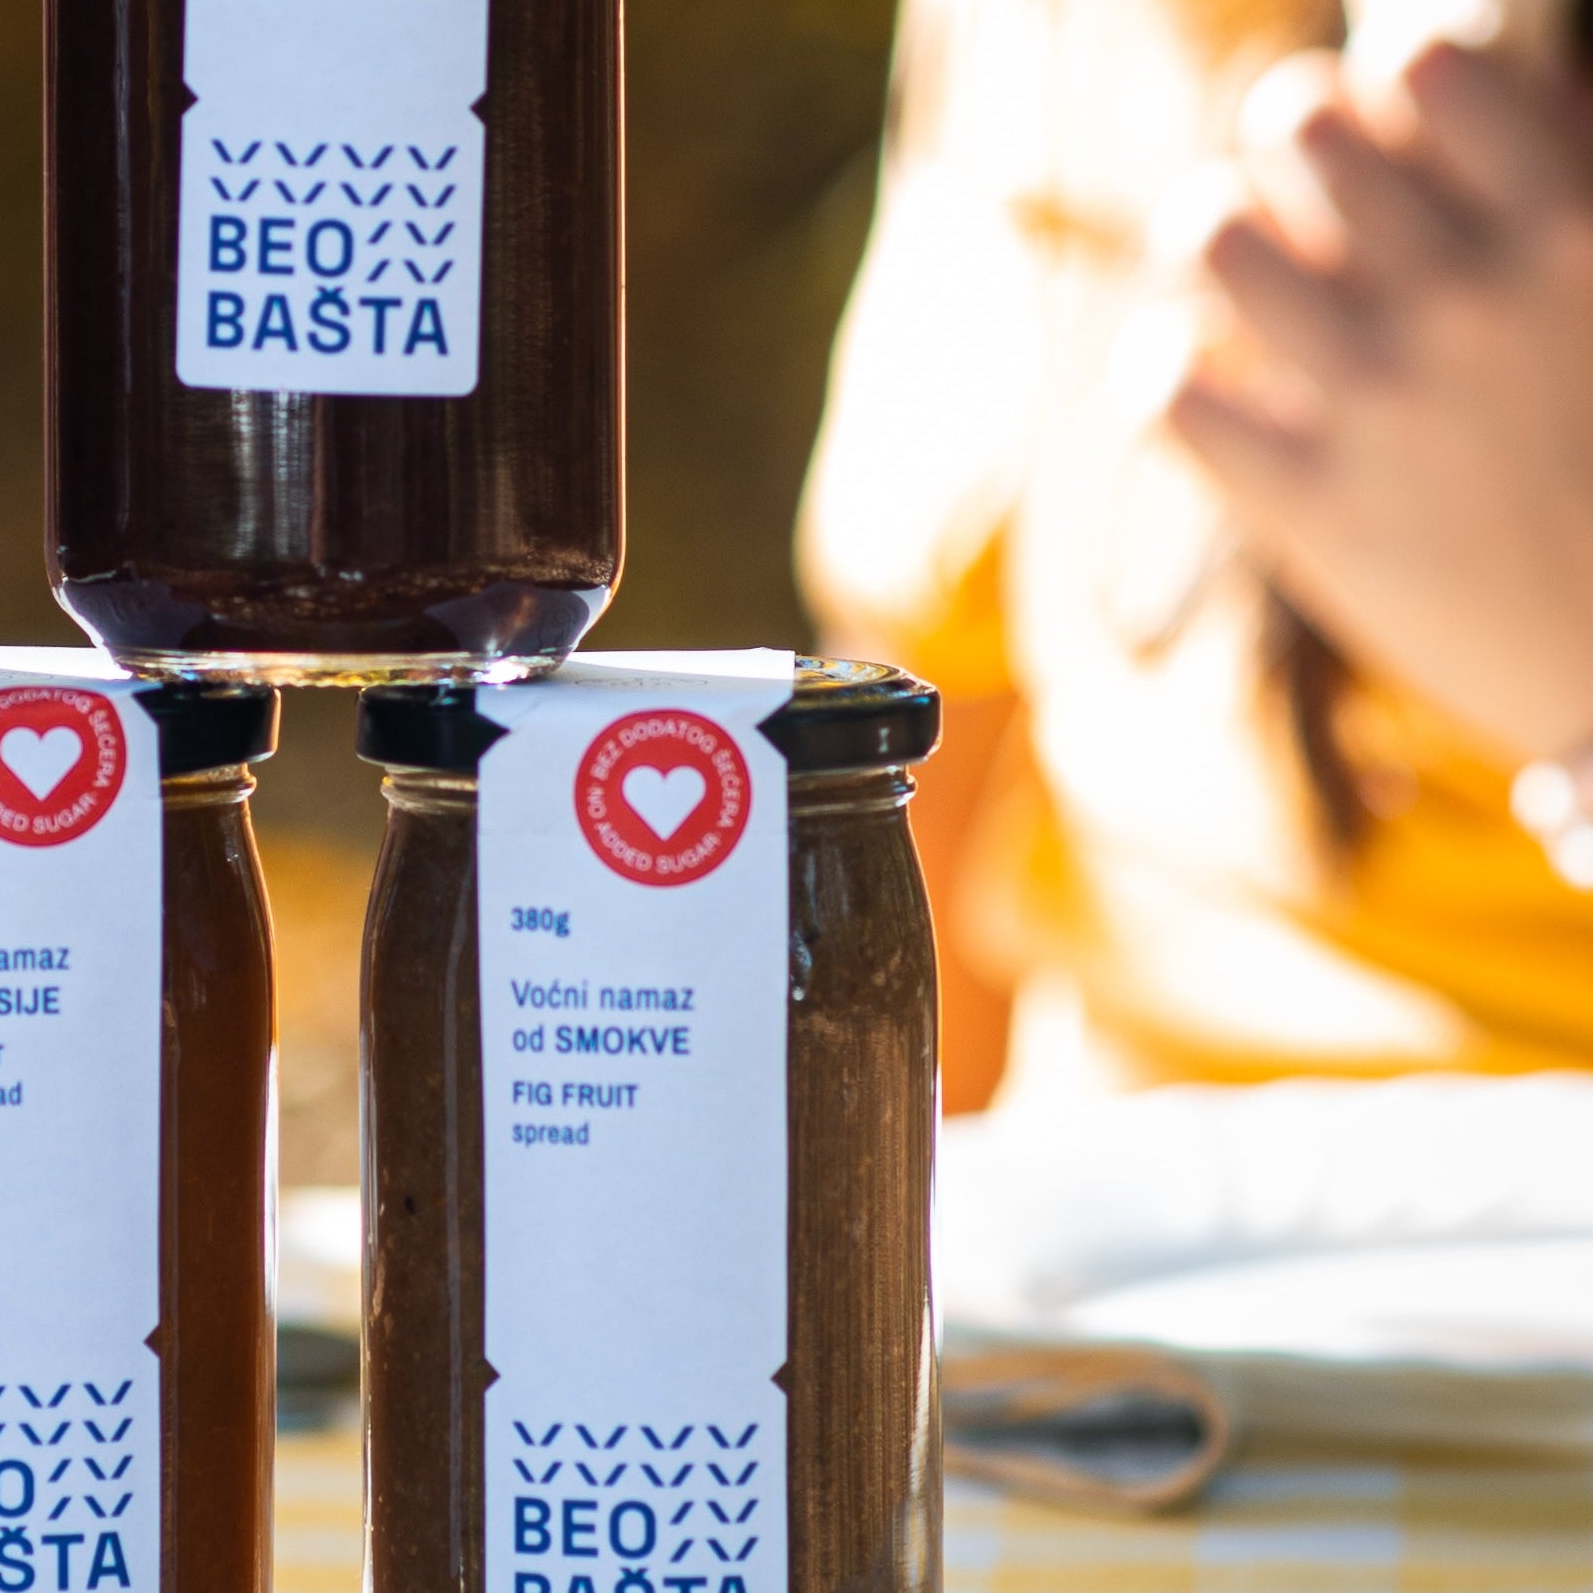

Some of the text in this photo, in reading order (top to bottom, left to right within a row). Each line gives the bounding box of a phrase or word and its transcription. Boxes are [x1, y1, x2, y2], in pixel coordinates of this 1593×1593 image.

[209, 215, 354, 278] BEO
[207, 286, 448, 356] BAŠTA
[512, 907, 570, 937] 380g
[511, 980, 693, 1011] Voćni namaz
[513, 1025, 688, 1055] od SMOKVE
[513, 1081, 638, 1108] FIG FRUIT
[512, 1123, 589, 1146] spread
[514, 1497, 656, 1560] BEO
